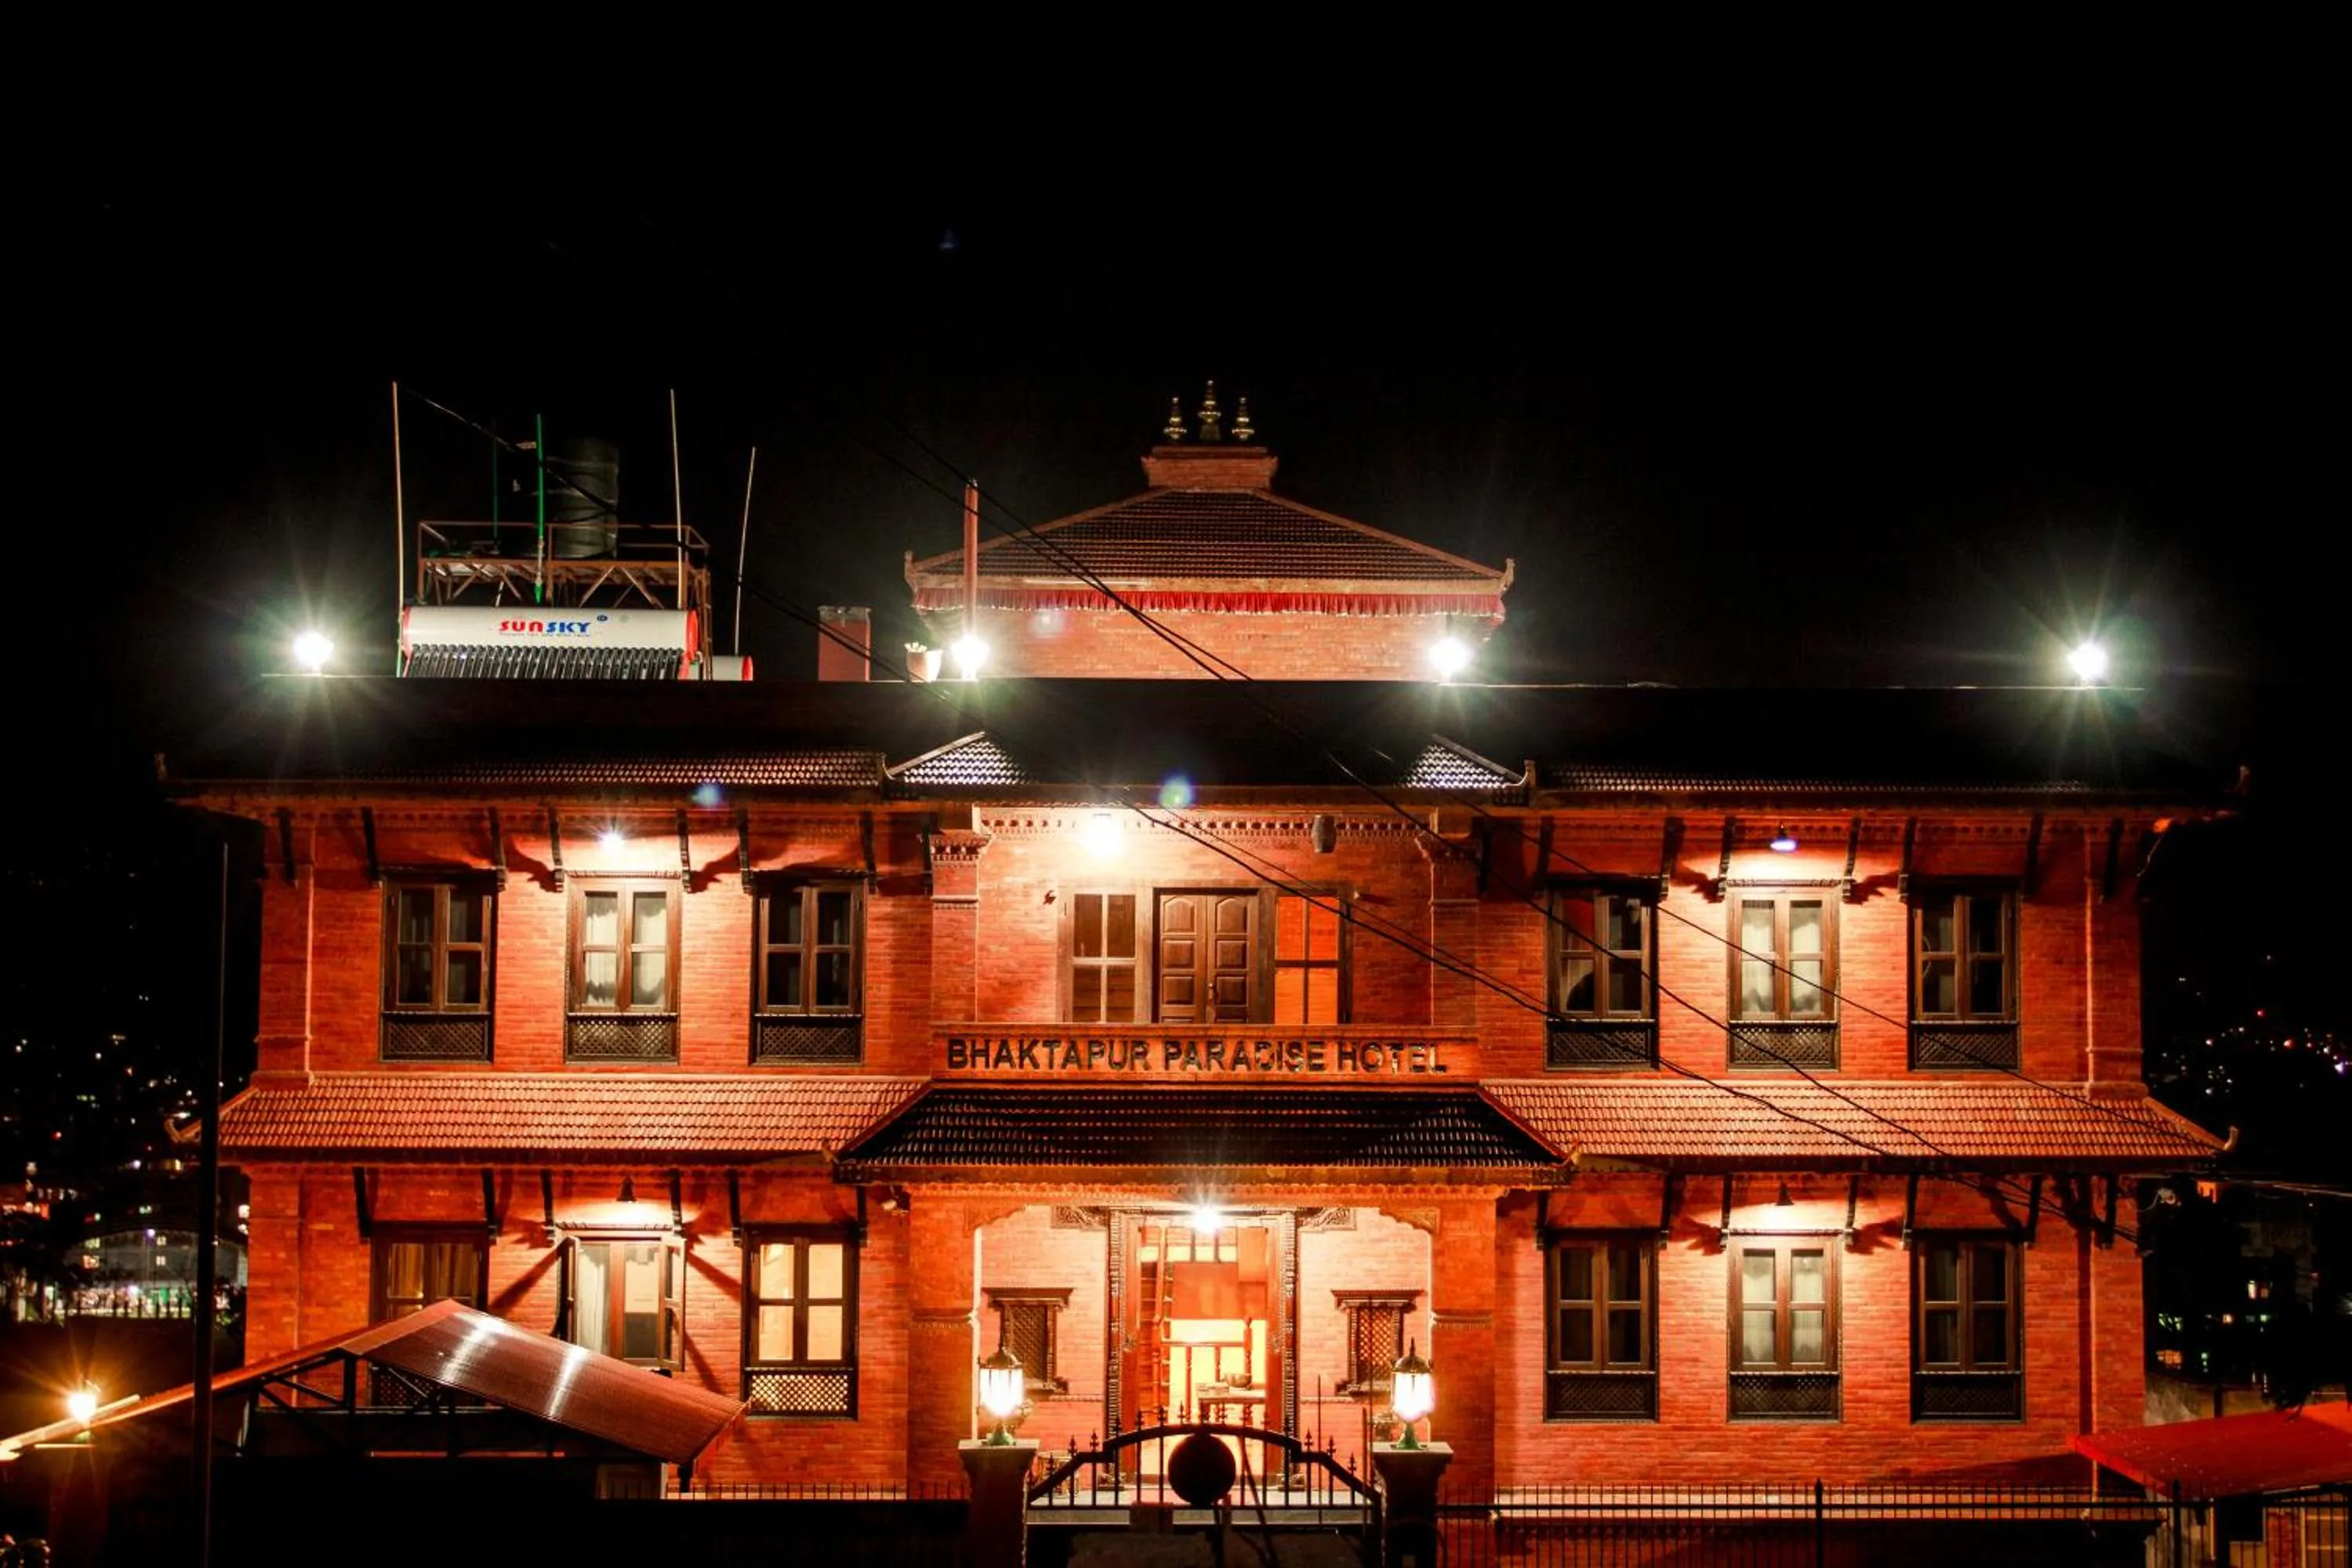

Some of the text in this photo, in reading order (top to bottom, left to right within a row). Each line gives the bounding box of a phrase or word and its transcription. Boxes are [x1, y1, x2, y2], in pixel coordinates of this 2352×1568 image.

[947, 1038, 1447, 1074] BHAKTAPUR PARADISE HOTEL
